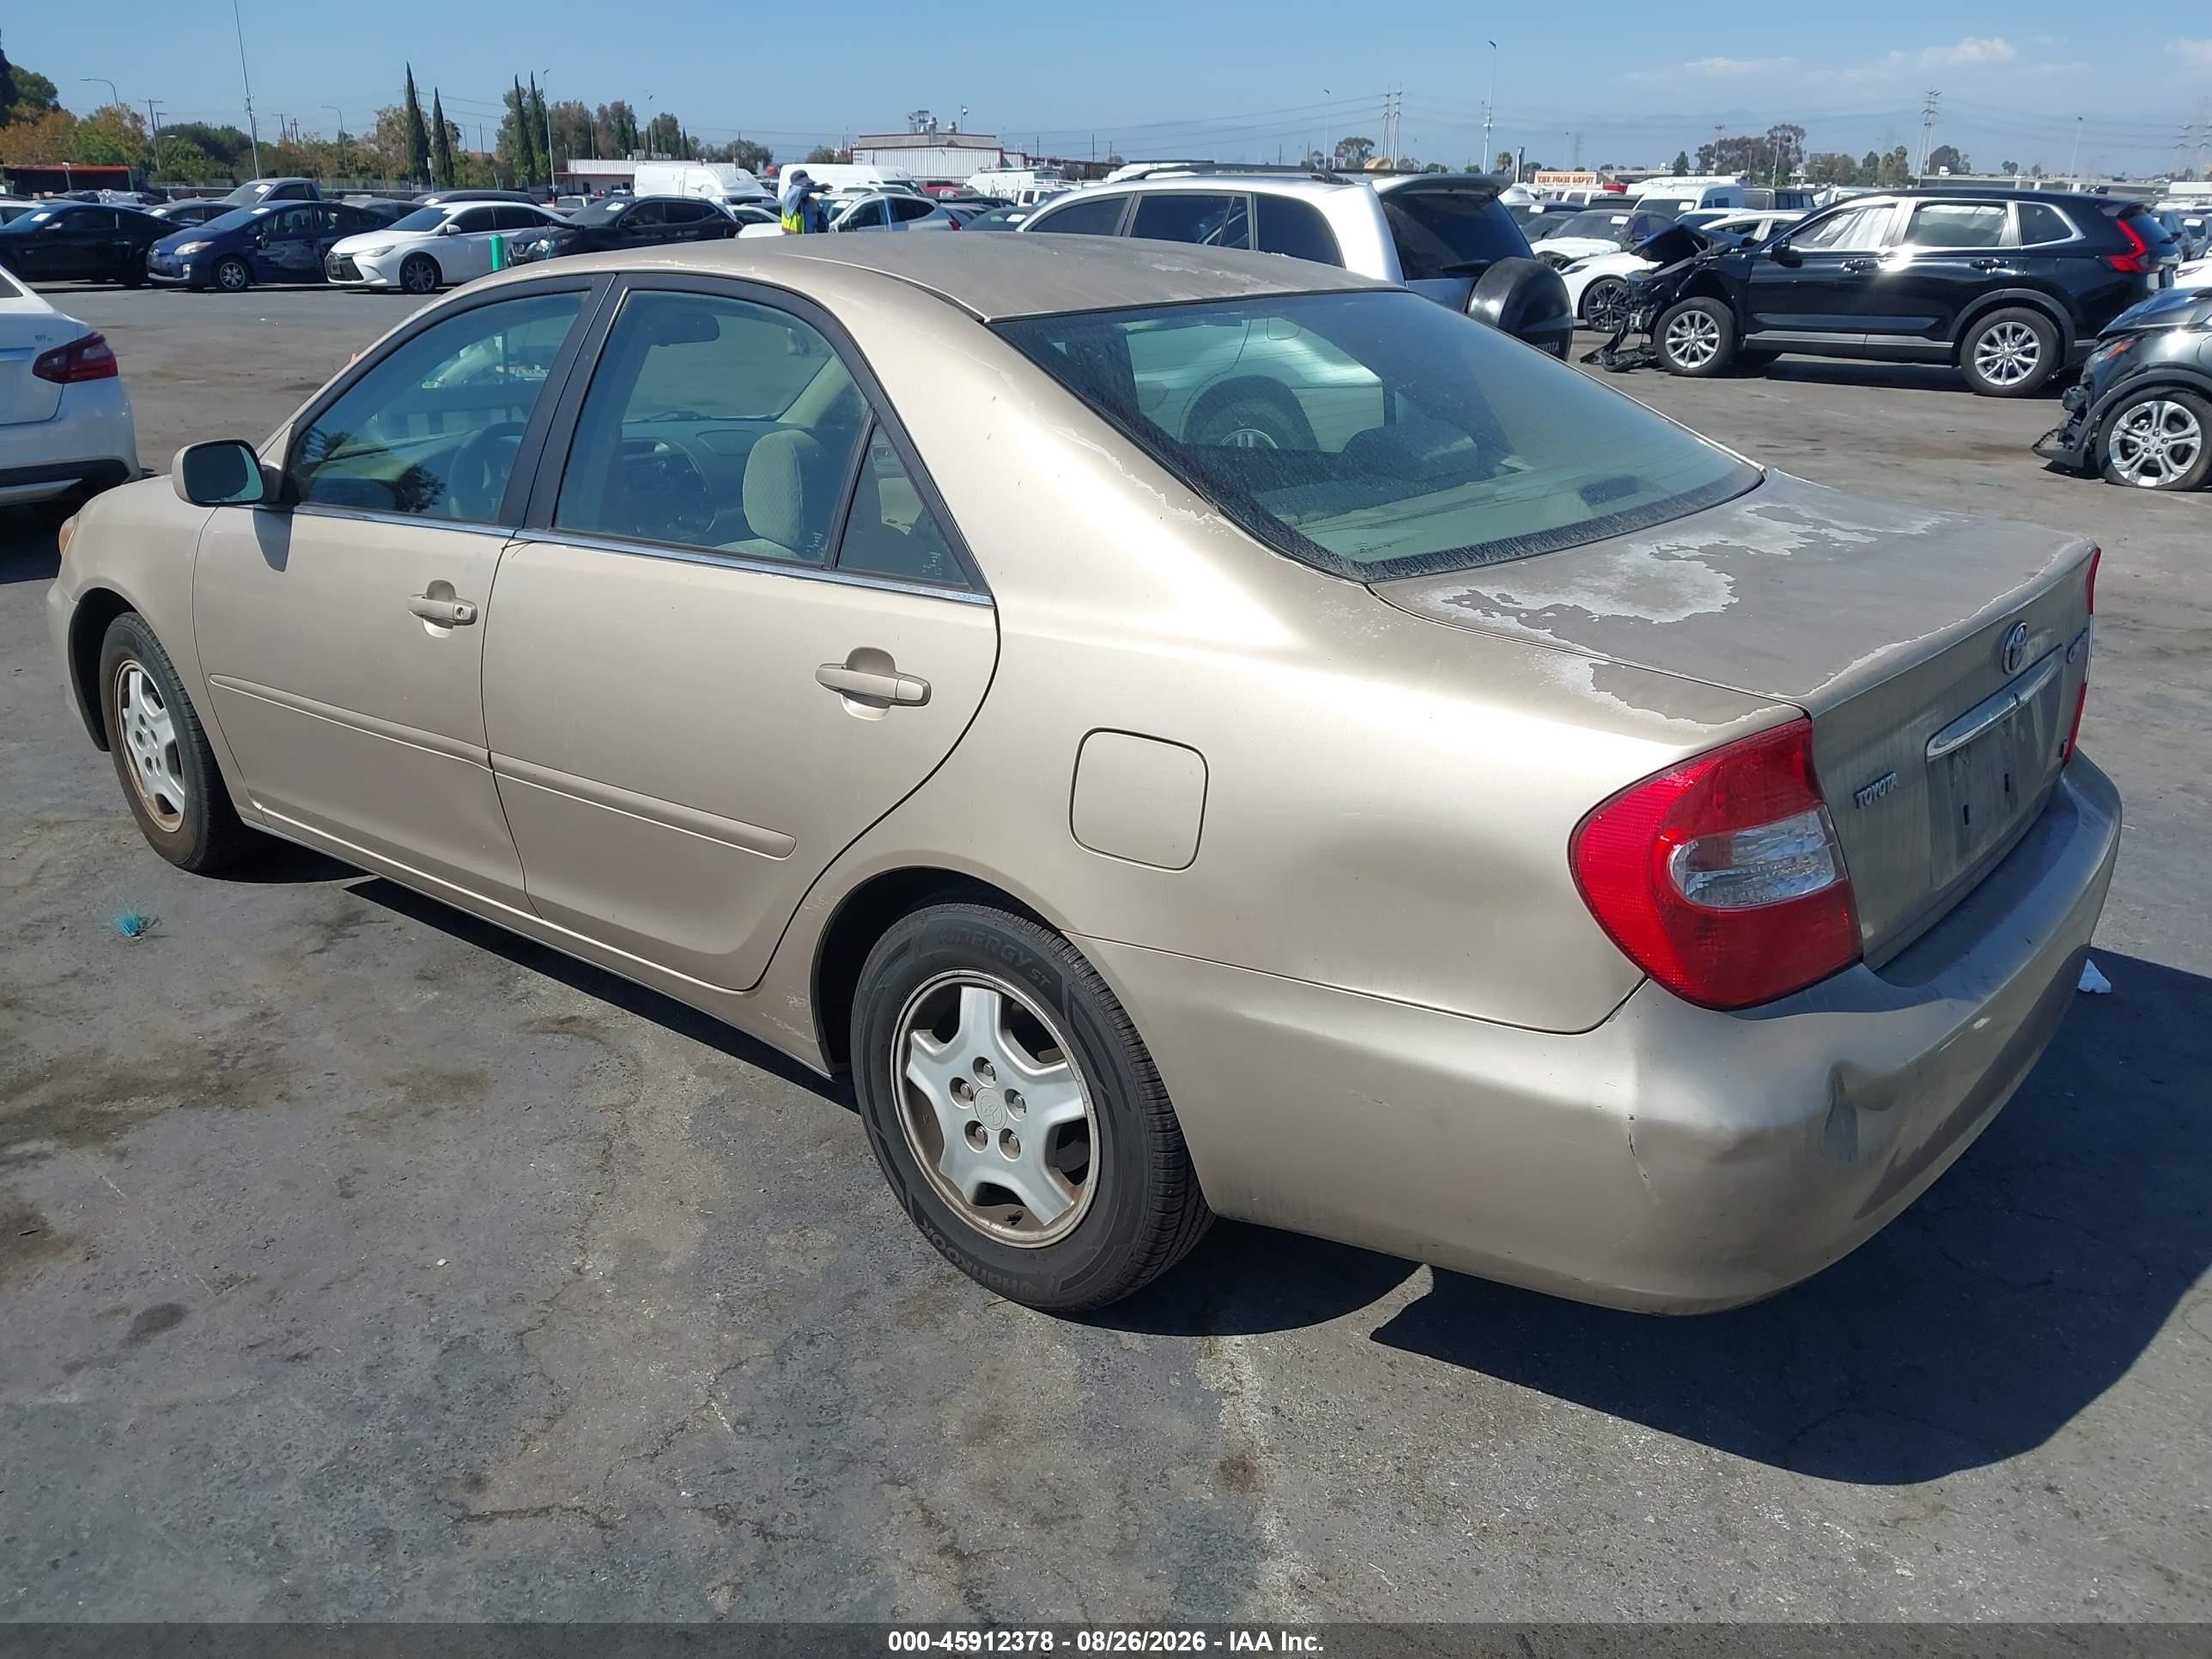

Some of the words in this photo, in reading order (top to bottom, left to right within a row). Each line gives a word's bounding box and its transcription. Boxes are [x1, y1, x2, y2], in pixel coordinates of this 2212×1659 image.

[1537, 175, 1551, 184] THE
[1553, 175, 1571, 184] HOME
[1572, 175, 1595, 184] DEPOT
[1853, 771, 1897, 811] TOYOTA
[1030, 968, 1052, 988] ST
